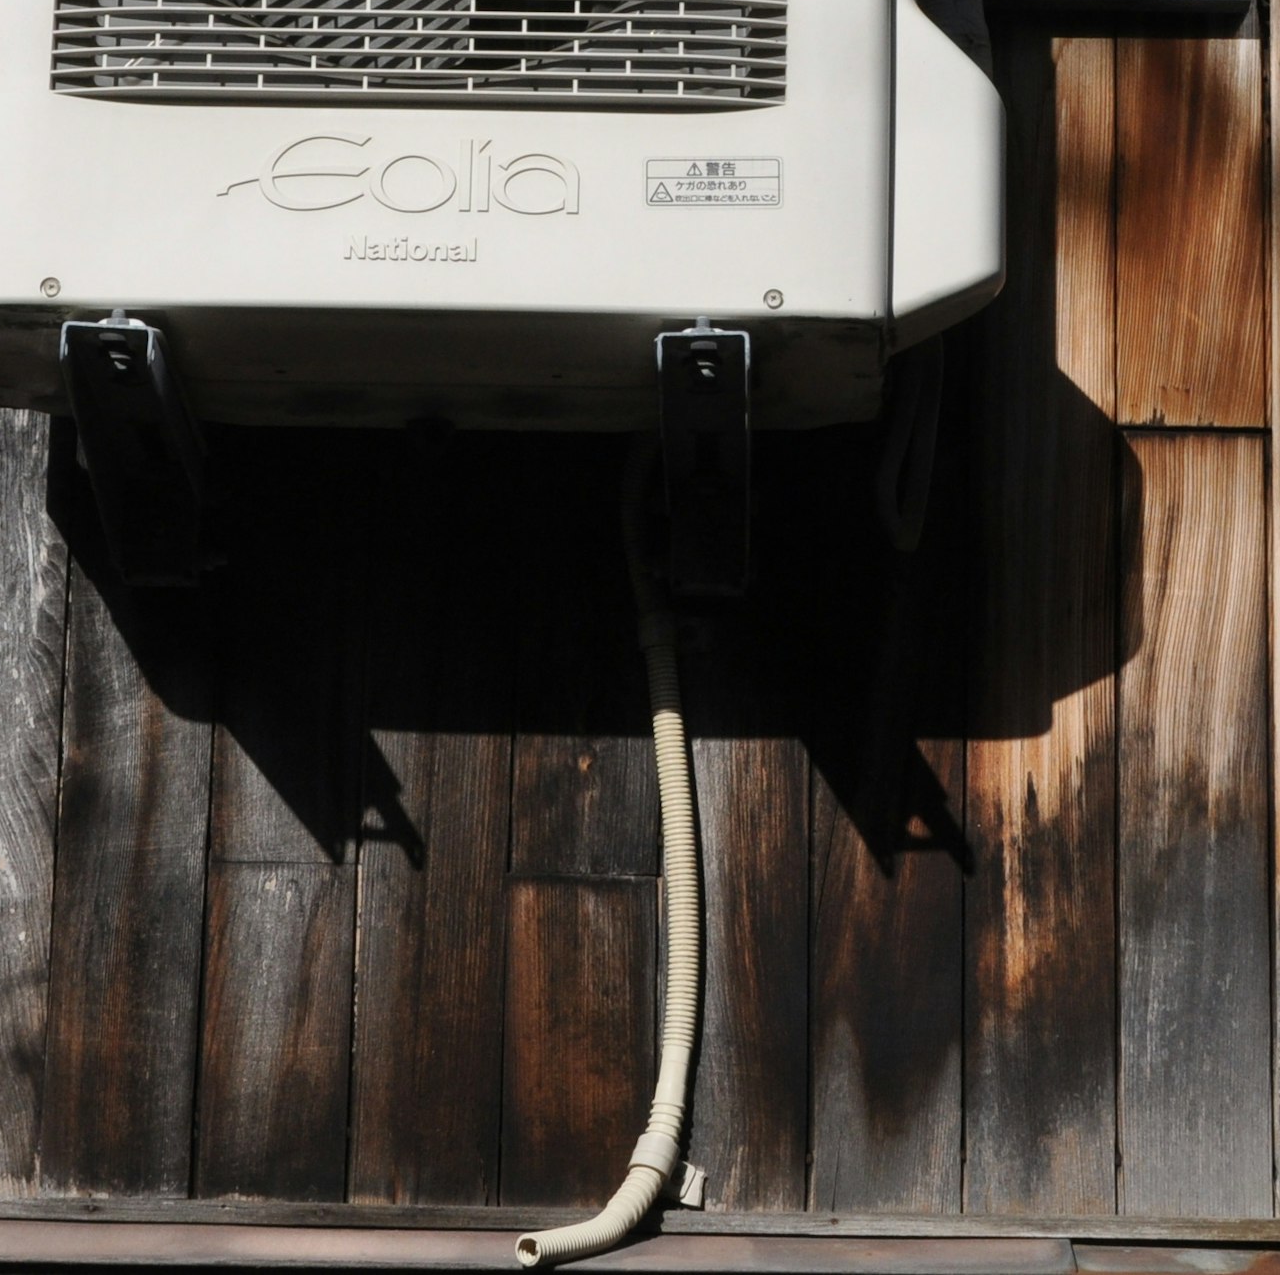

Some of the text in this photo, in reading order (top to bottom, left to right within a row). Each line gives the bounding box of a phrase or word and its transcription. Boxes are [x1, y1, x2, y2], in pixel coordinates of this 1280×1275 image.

[216, 133, 581, 216] Eolia
[706, 162, 736, 177] 警告
[675, 180, 747, 191] ケガの恐れあり
[343, 234, 478, 263] National
